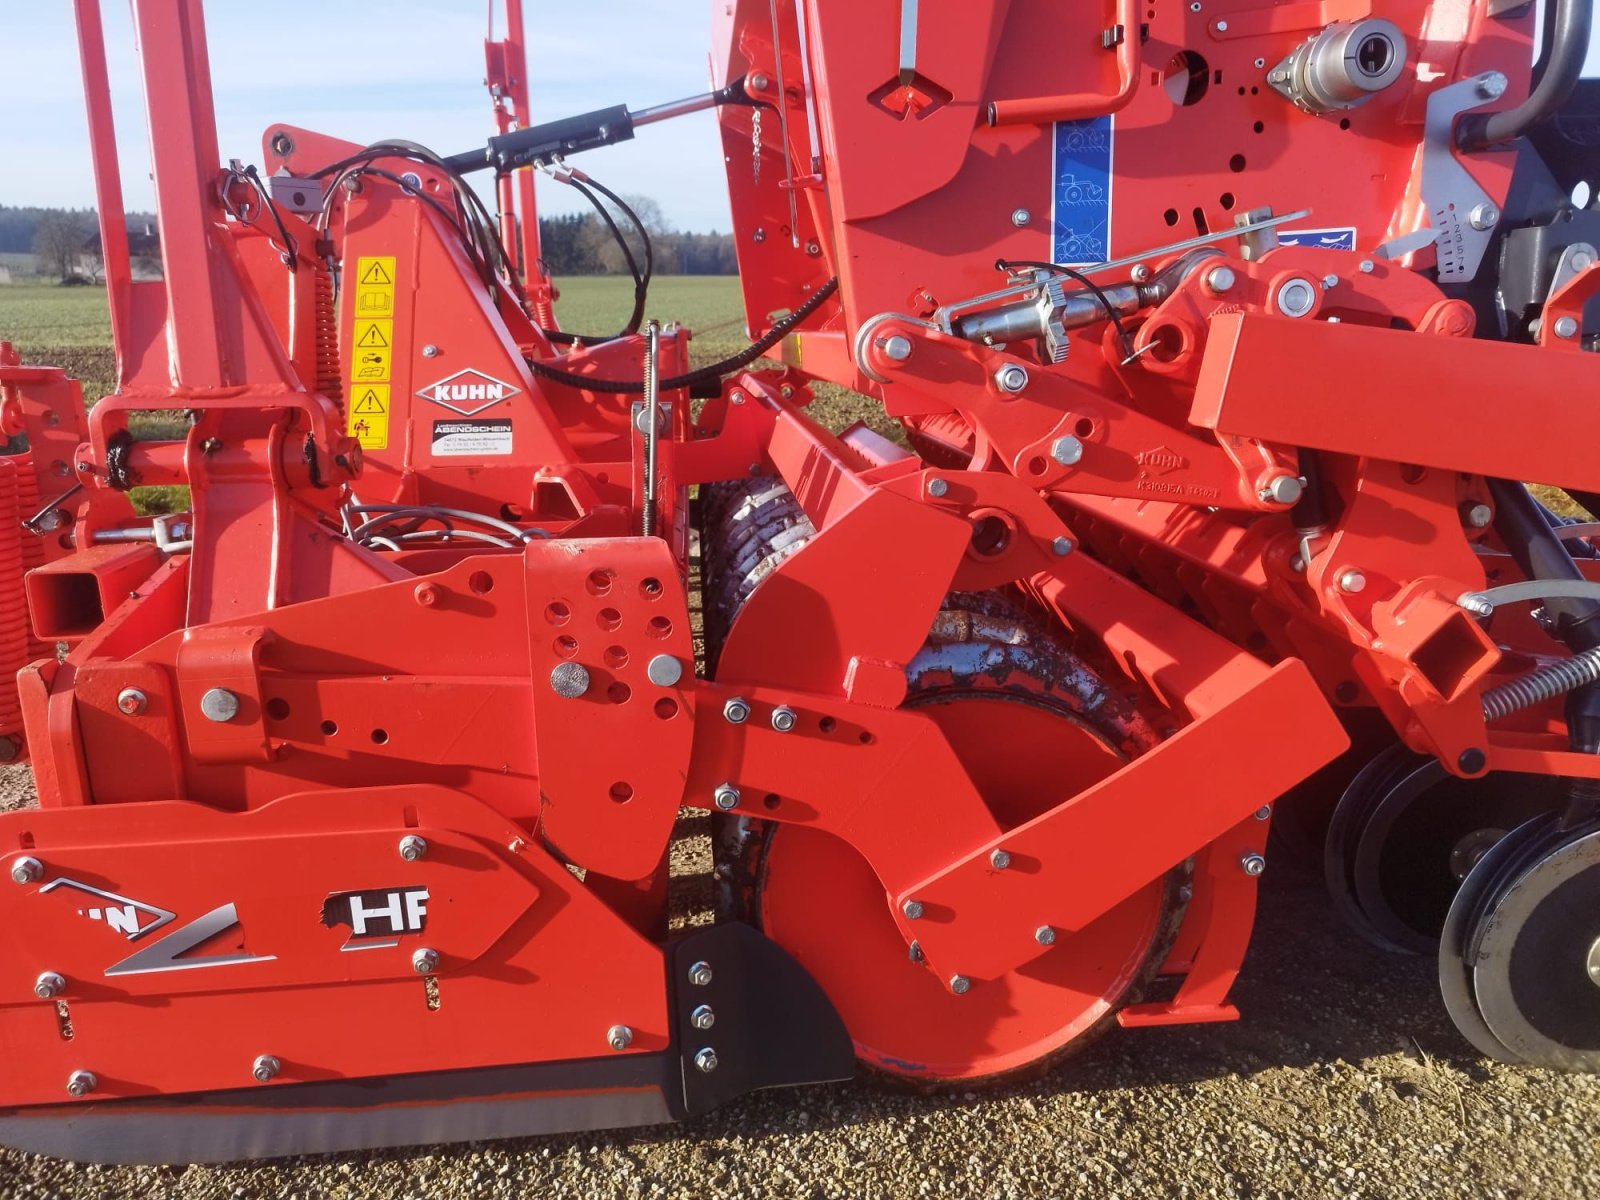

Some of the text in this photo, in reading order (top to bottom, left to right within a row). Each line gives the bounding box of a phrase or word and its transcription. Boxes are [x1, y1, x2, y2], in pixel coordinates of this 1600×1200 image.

[1454, 224, 1461, 233] 2
[1455, 234, 1463, 243] 3
[1457, 246, 1464, 254] 5
[434, 384, 503, 401] KUHN
[1137, 452, 1183, 468] KUHN
